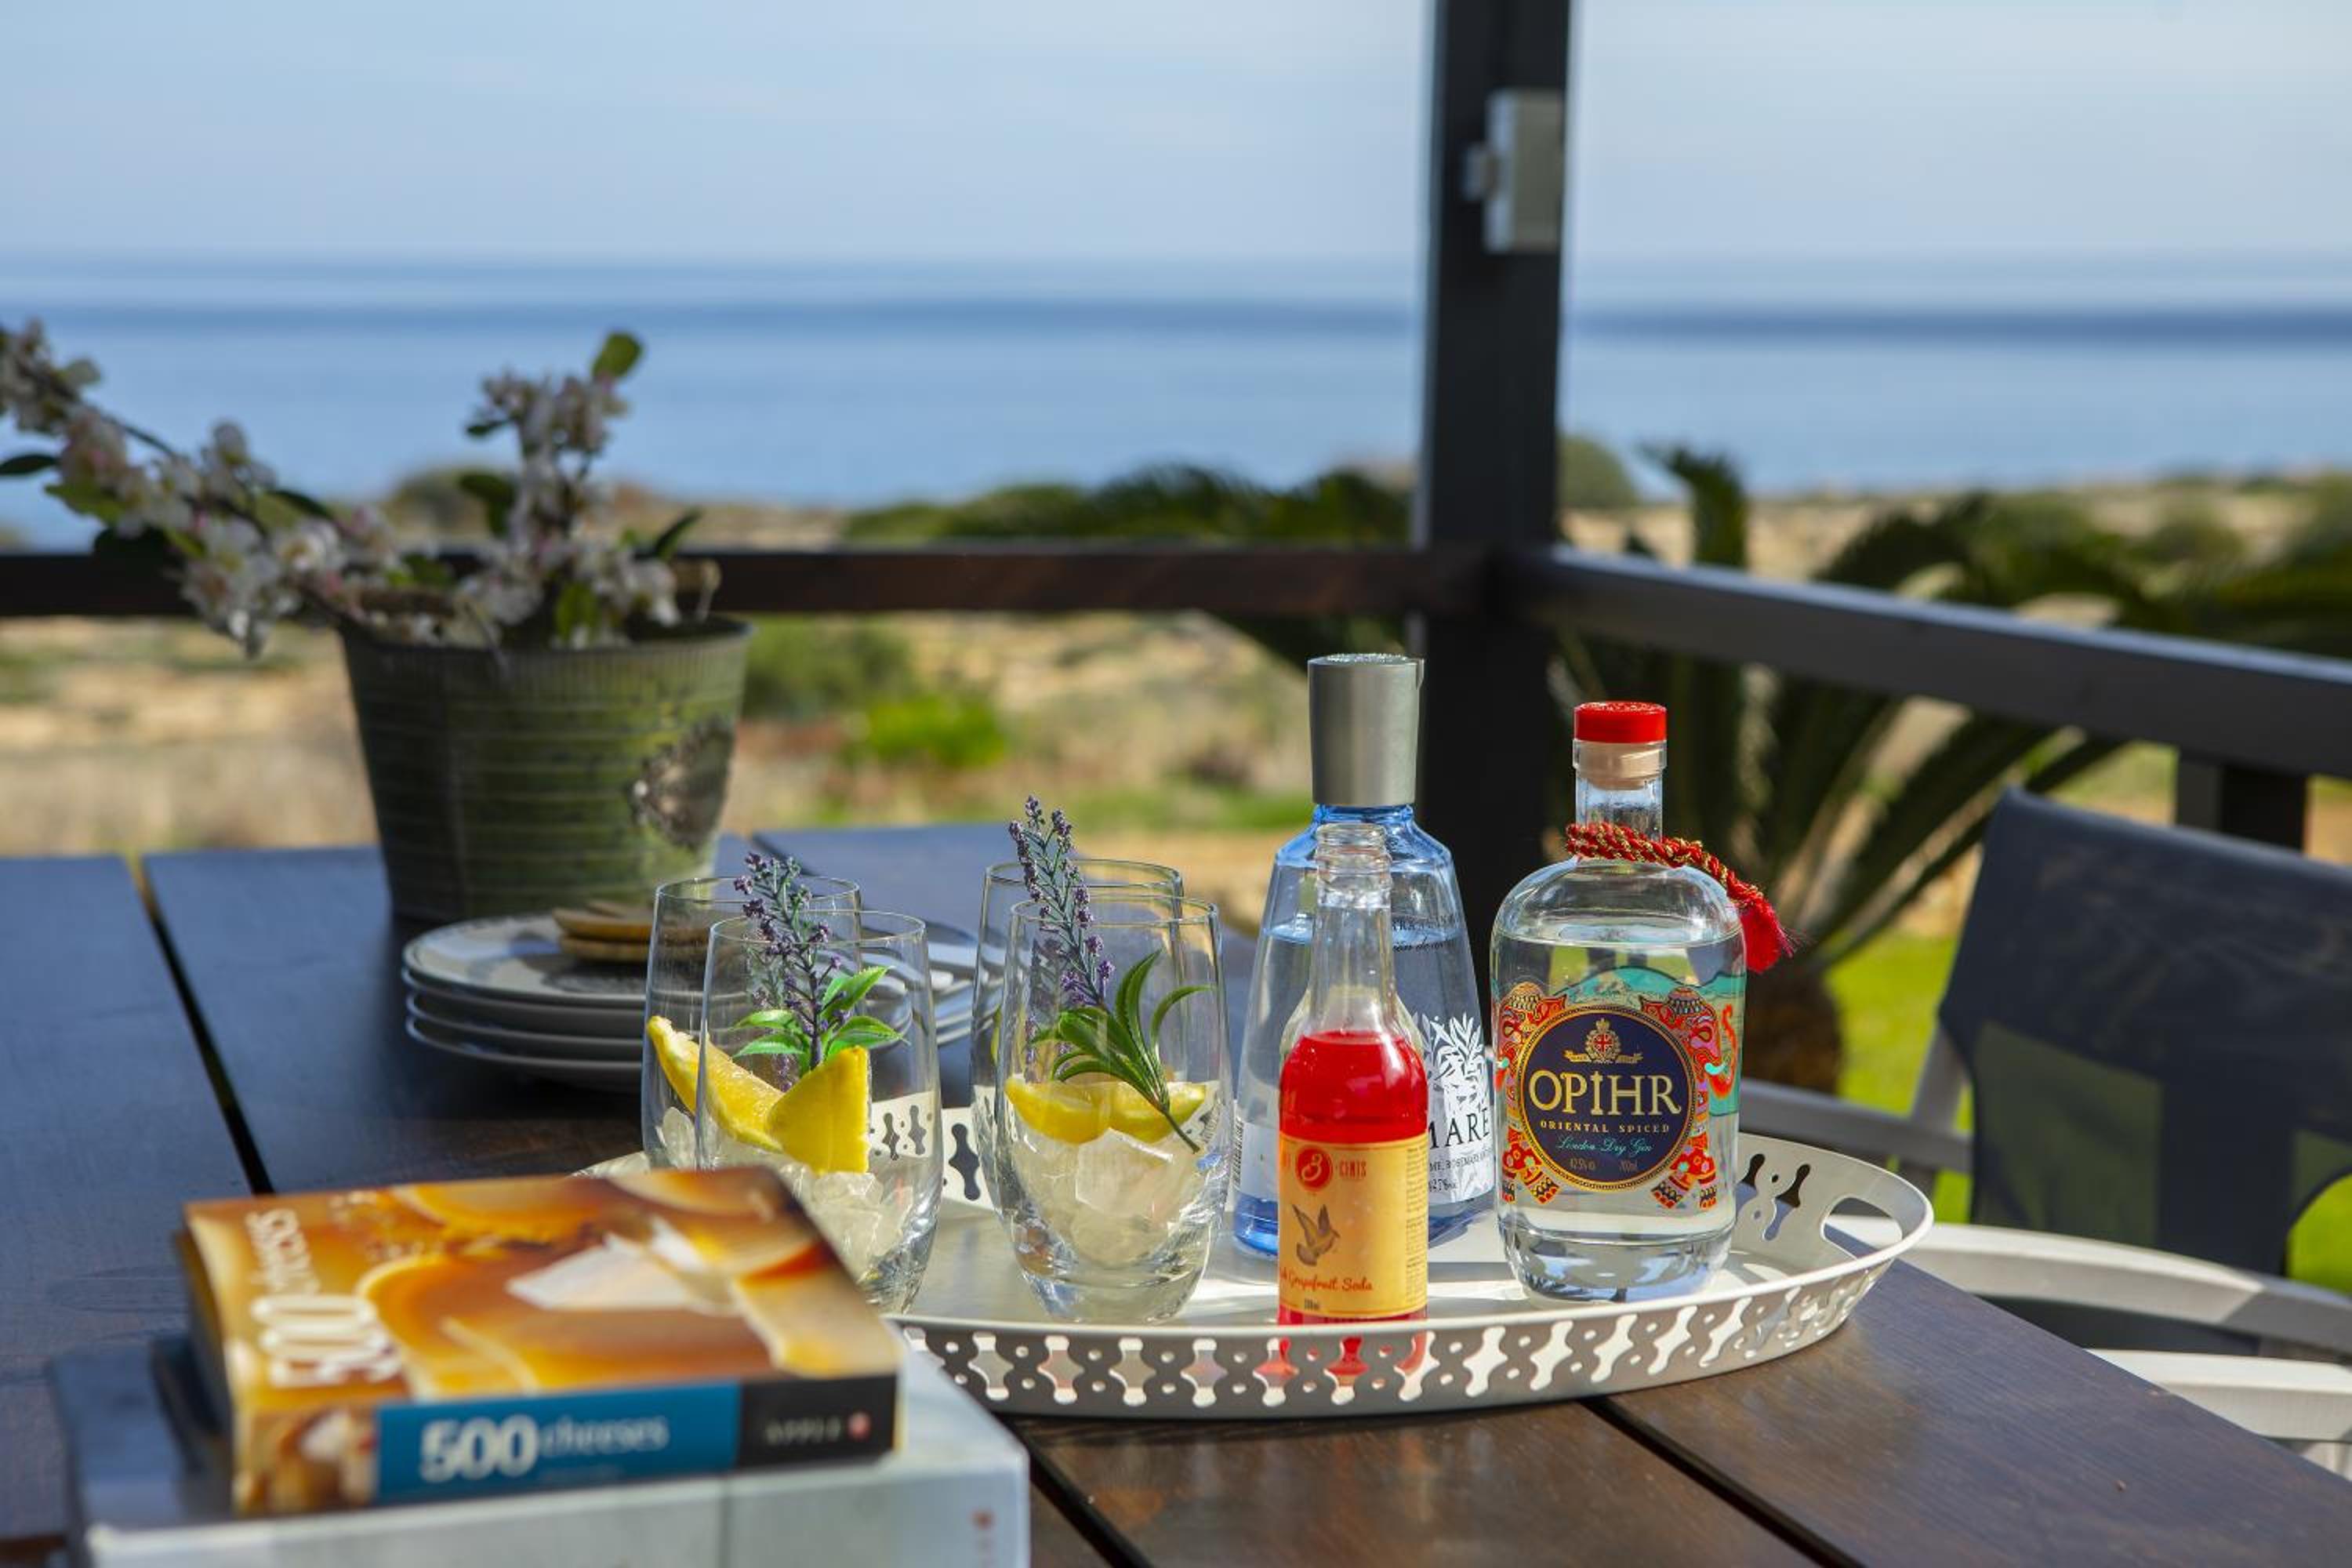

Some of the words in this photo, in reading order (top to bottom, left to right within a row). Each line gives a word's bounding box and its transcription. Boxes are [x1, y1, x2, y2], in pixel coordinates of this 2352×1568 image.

[1529, 1069, 1682, 1116] OPIHR
[1540, 1120, 1610, 1133] ORIENTAL
[1619, 1124, 1670, 1134] SPICED
[1556, 1134, 1596, 1152] London
[1600, 1137, 1626, 1156] Dry
[1629, 1137, 1654, 1157] Gin
[1339, 1160, 1367, 1178] CENTS
[1341, 1276, 1374, 1293] Soda
[248, 1292, 405, 1389] 500
[419, 1414, 539, 1483] 500
[539, 1414, 671, 1458] cheeses
